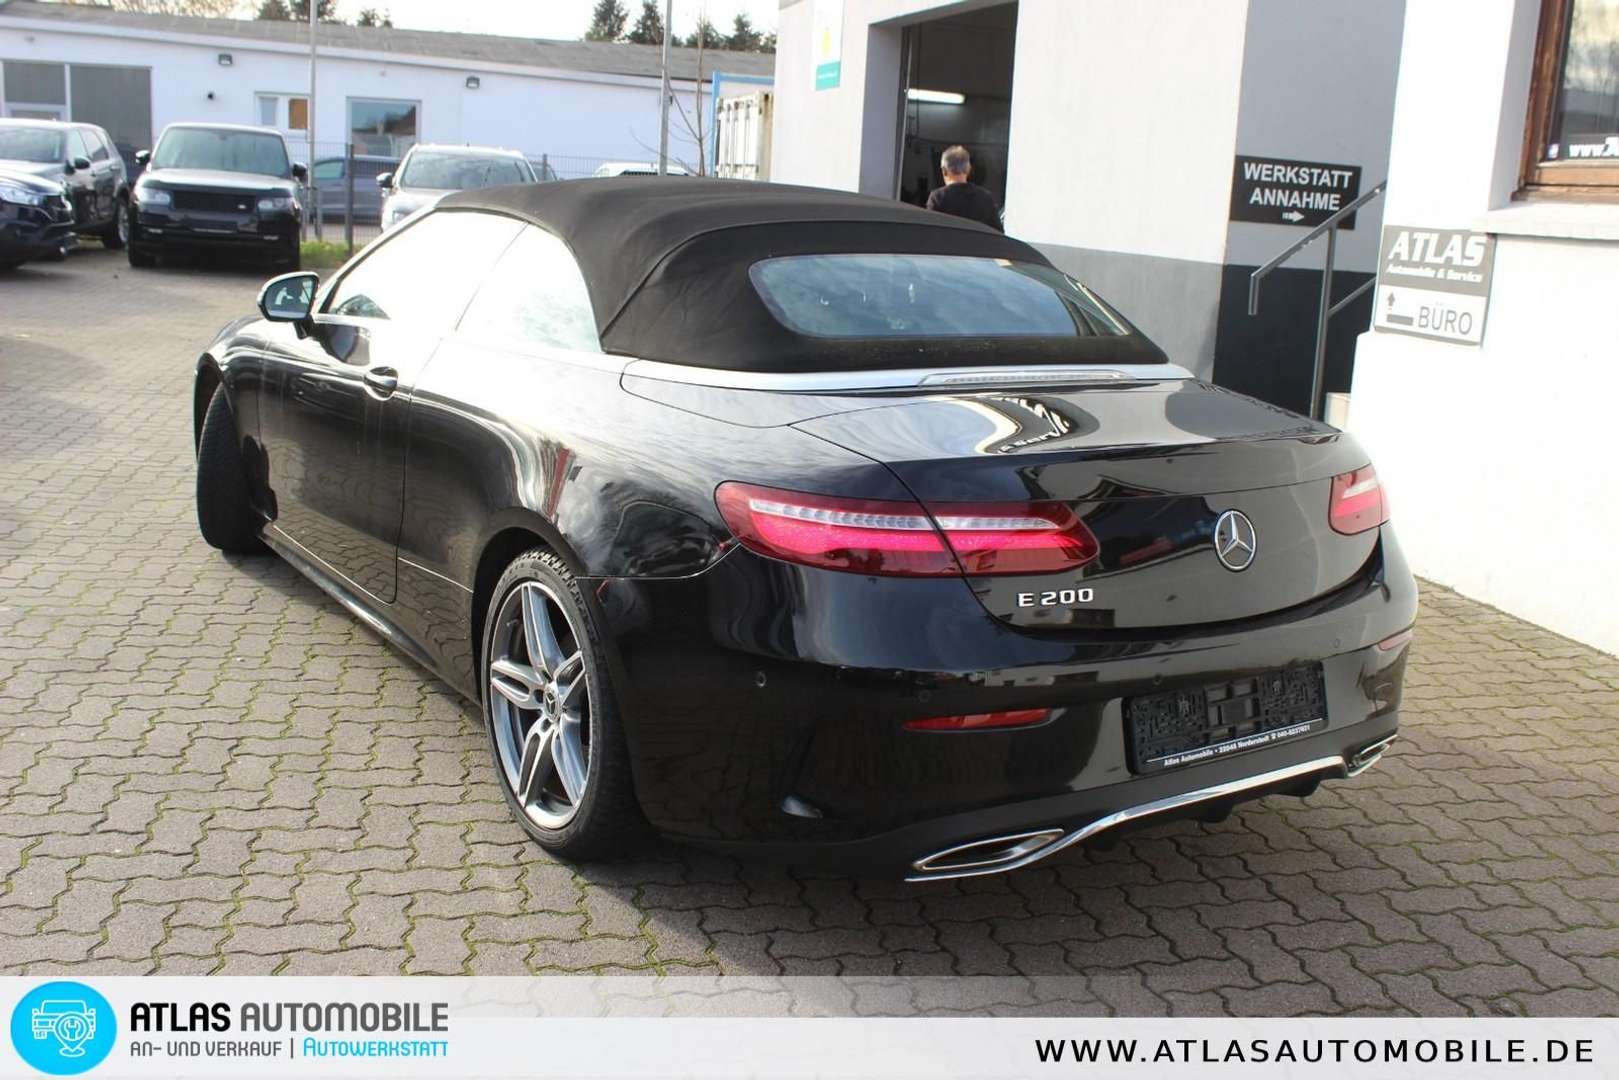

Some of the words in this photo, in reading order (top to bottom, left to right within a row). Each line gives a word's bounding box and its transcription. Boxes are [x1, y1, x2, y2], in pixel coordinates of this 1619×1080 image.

[1243, 161, 1353, 189] WERKSTATT
[1249, 187, 1341, 211] ANNAHME
[1388, 231, 1488, 267] ATLAS
[1418, 301, 1473, 335] BÜRO
[1018, 592, 1035, 607] E
[1040, 588, 1094, 606] 200
[1164, 757, 1180, 766] Atlas
[1181, 749, 1214, 763] Automobile
